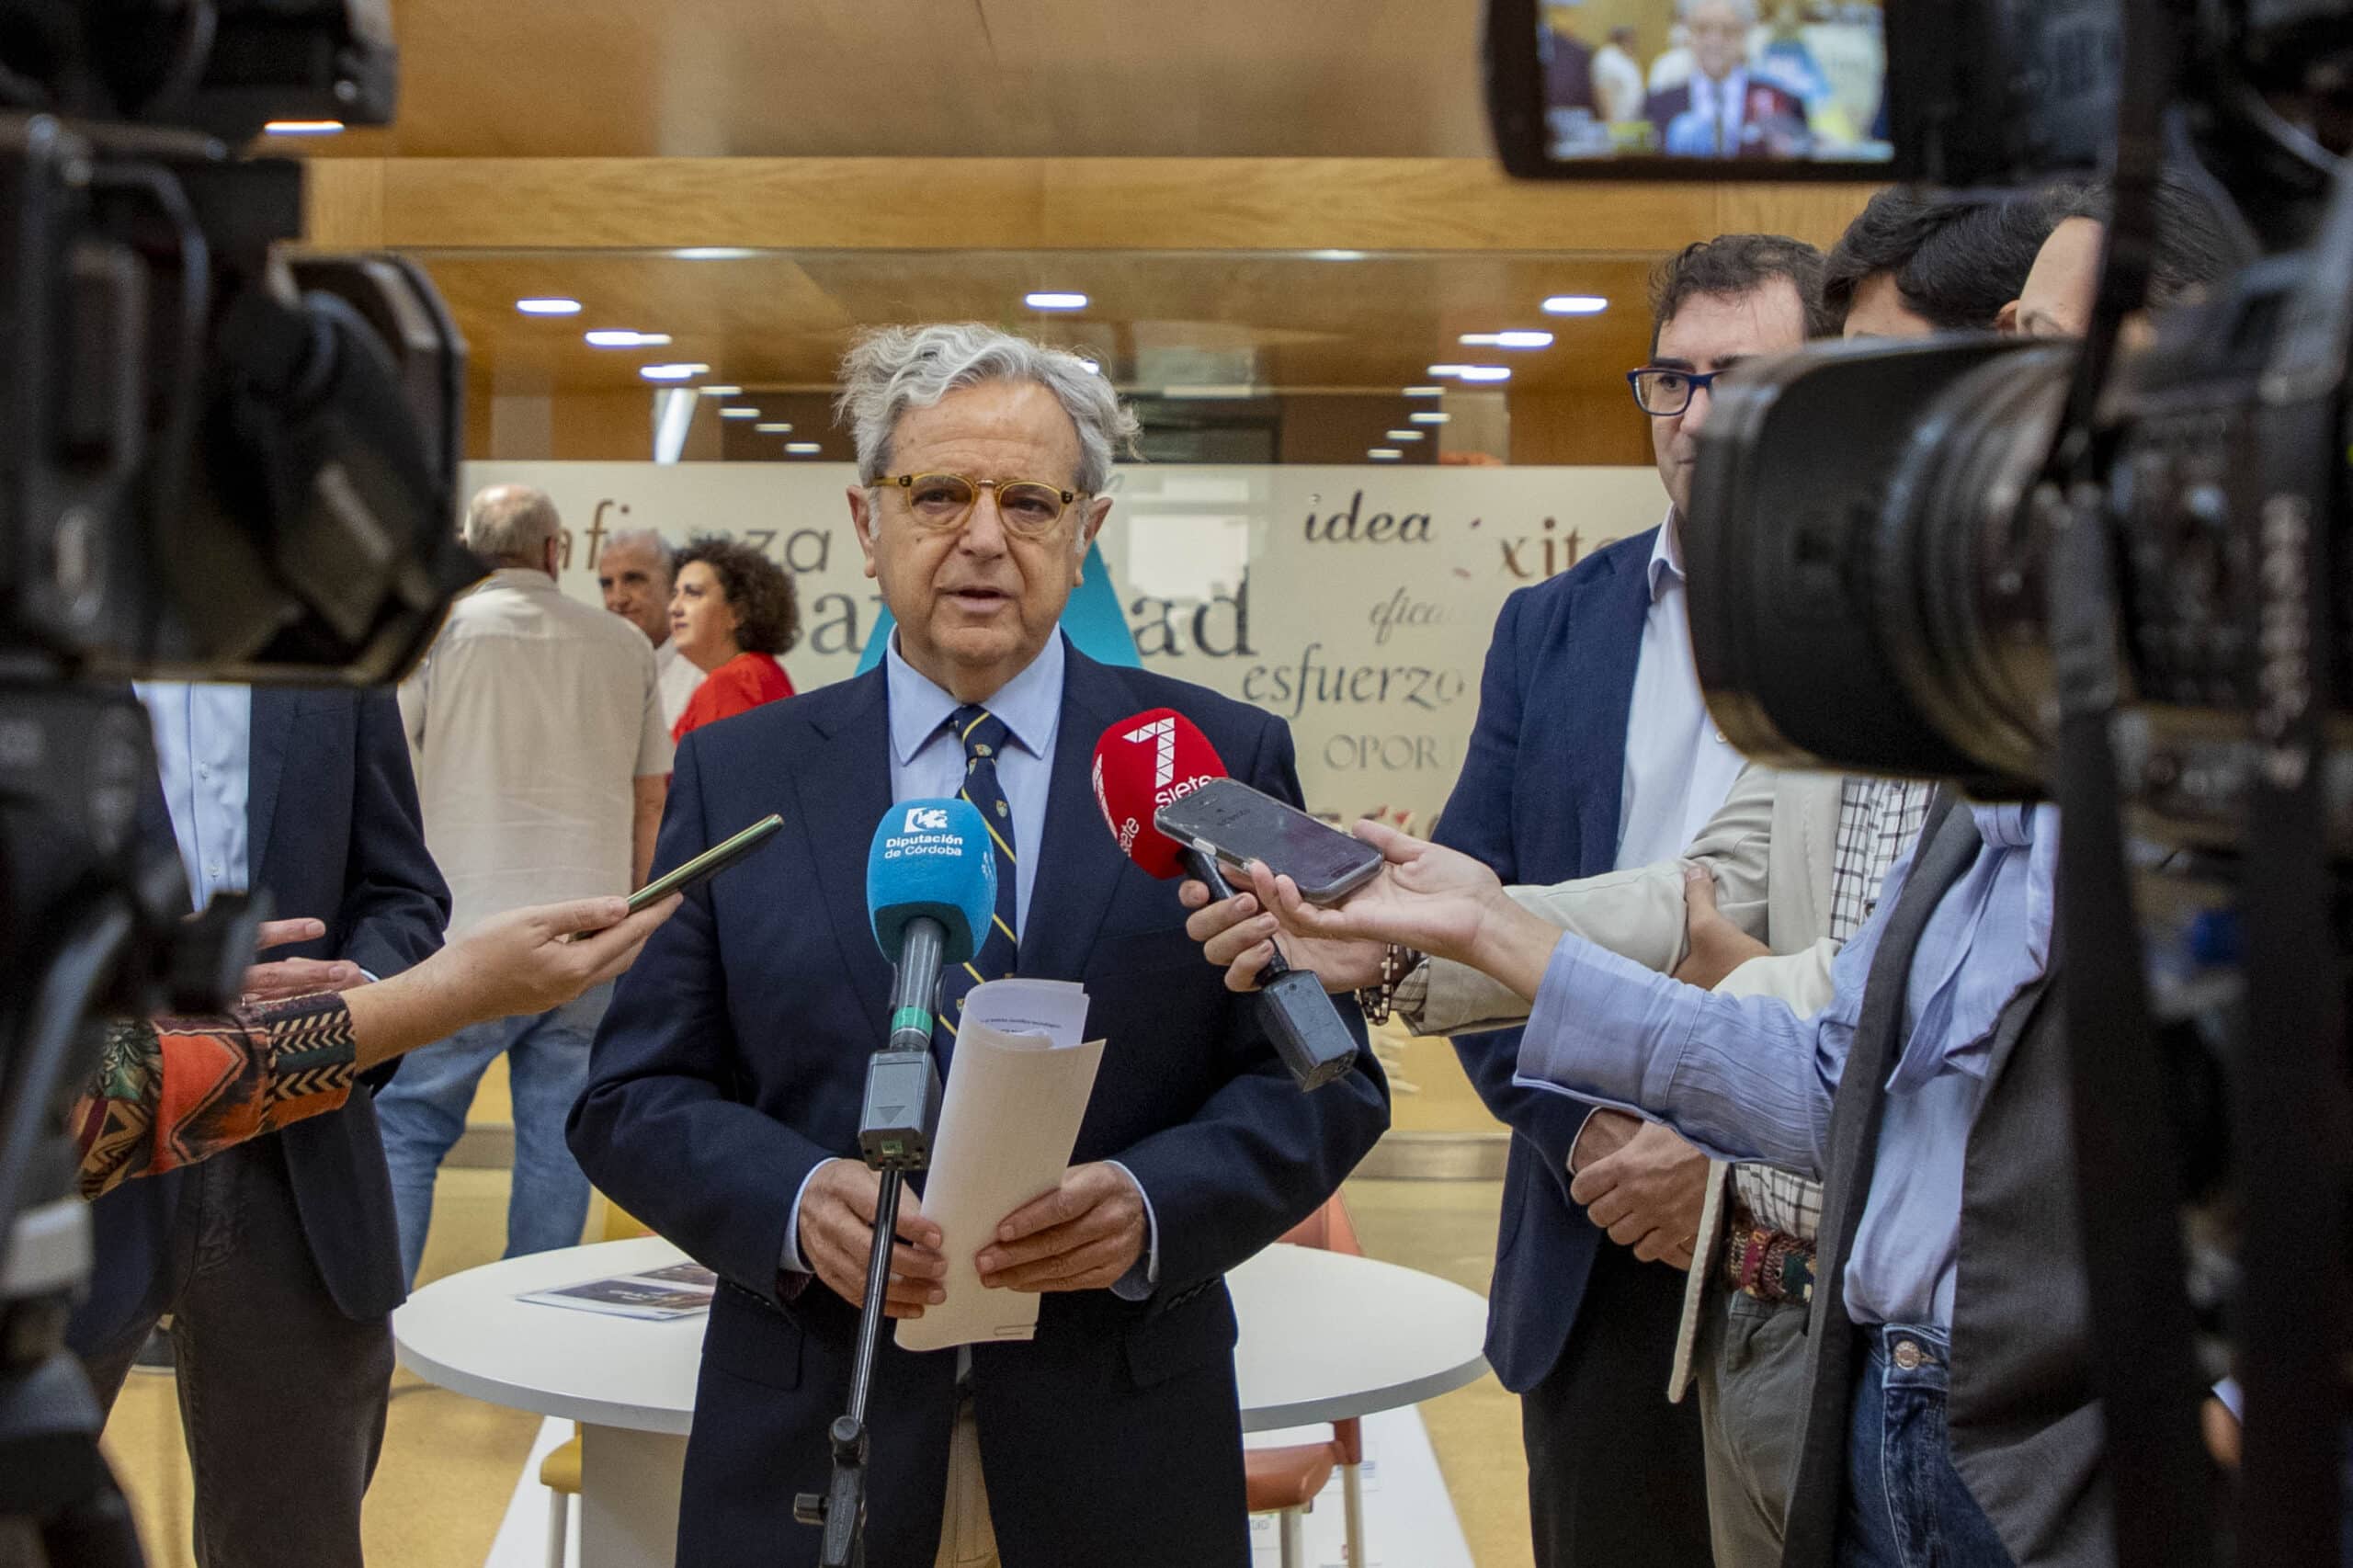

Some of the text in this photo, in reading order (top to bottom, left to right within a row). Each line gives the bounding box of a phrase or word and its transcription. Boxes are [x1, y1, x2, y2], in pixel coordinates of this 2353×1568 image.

[1305, 490, 1434, 543] idea
[1243, 643, 1464, 721] esfuerzo
[1121, 717, 1176, 790] 7
[1323, 734, 1455, 770] OPOR
[884, 844, 962, 859] de Córdoba
[885, 834, 963, 848] Diputación
